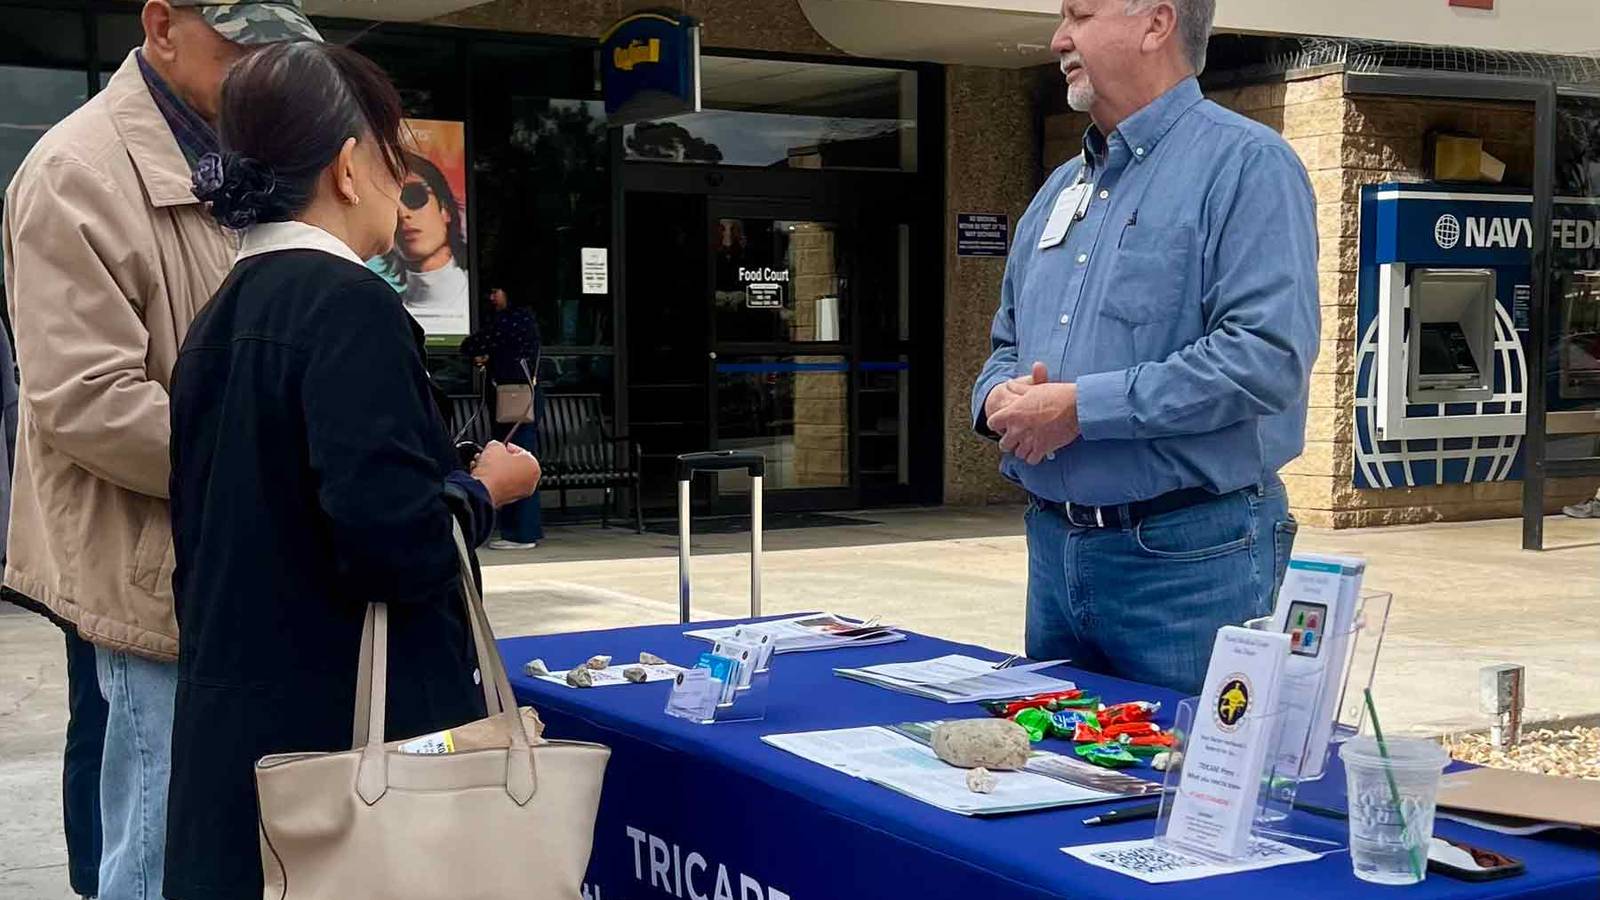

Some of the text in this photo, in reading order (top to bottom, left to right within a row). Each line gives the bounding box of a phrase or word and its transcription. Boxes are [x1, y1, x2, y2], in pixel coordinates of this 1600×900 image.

[738, 267, 790, 282] Food Court
[626, 825, 791, 900] TRICAR
